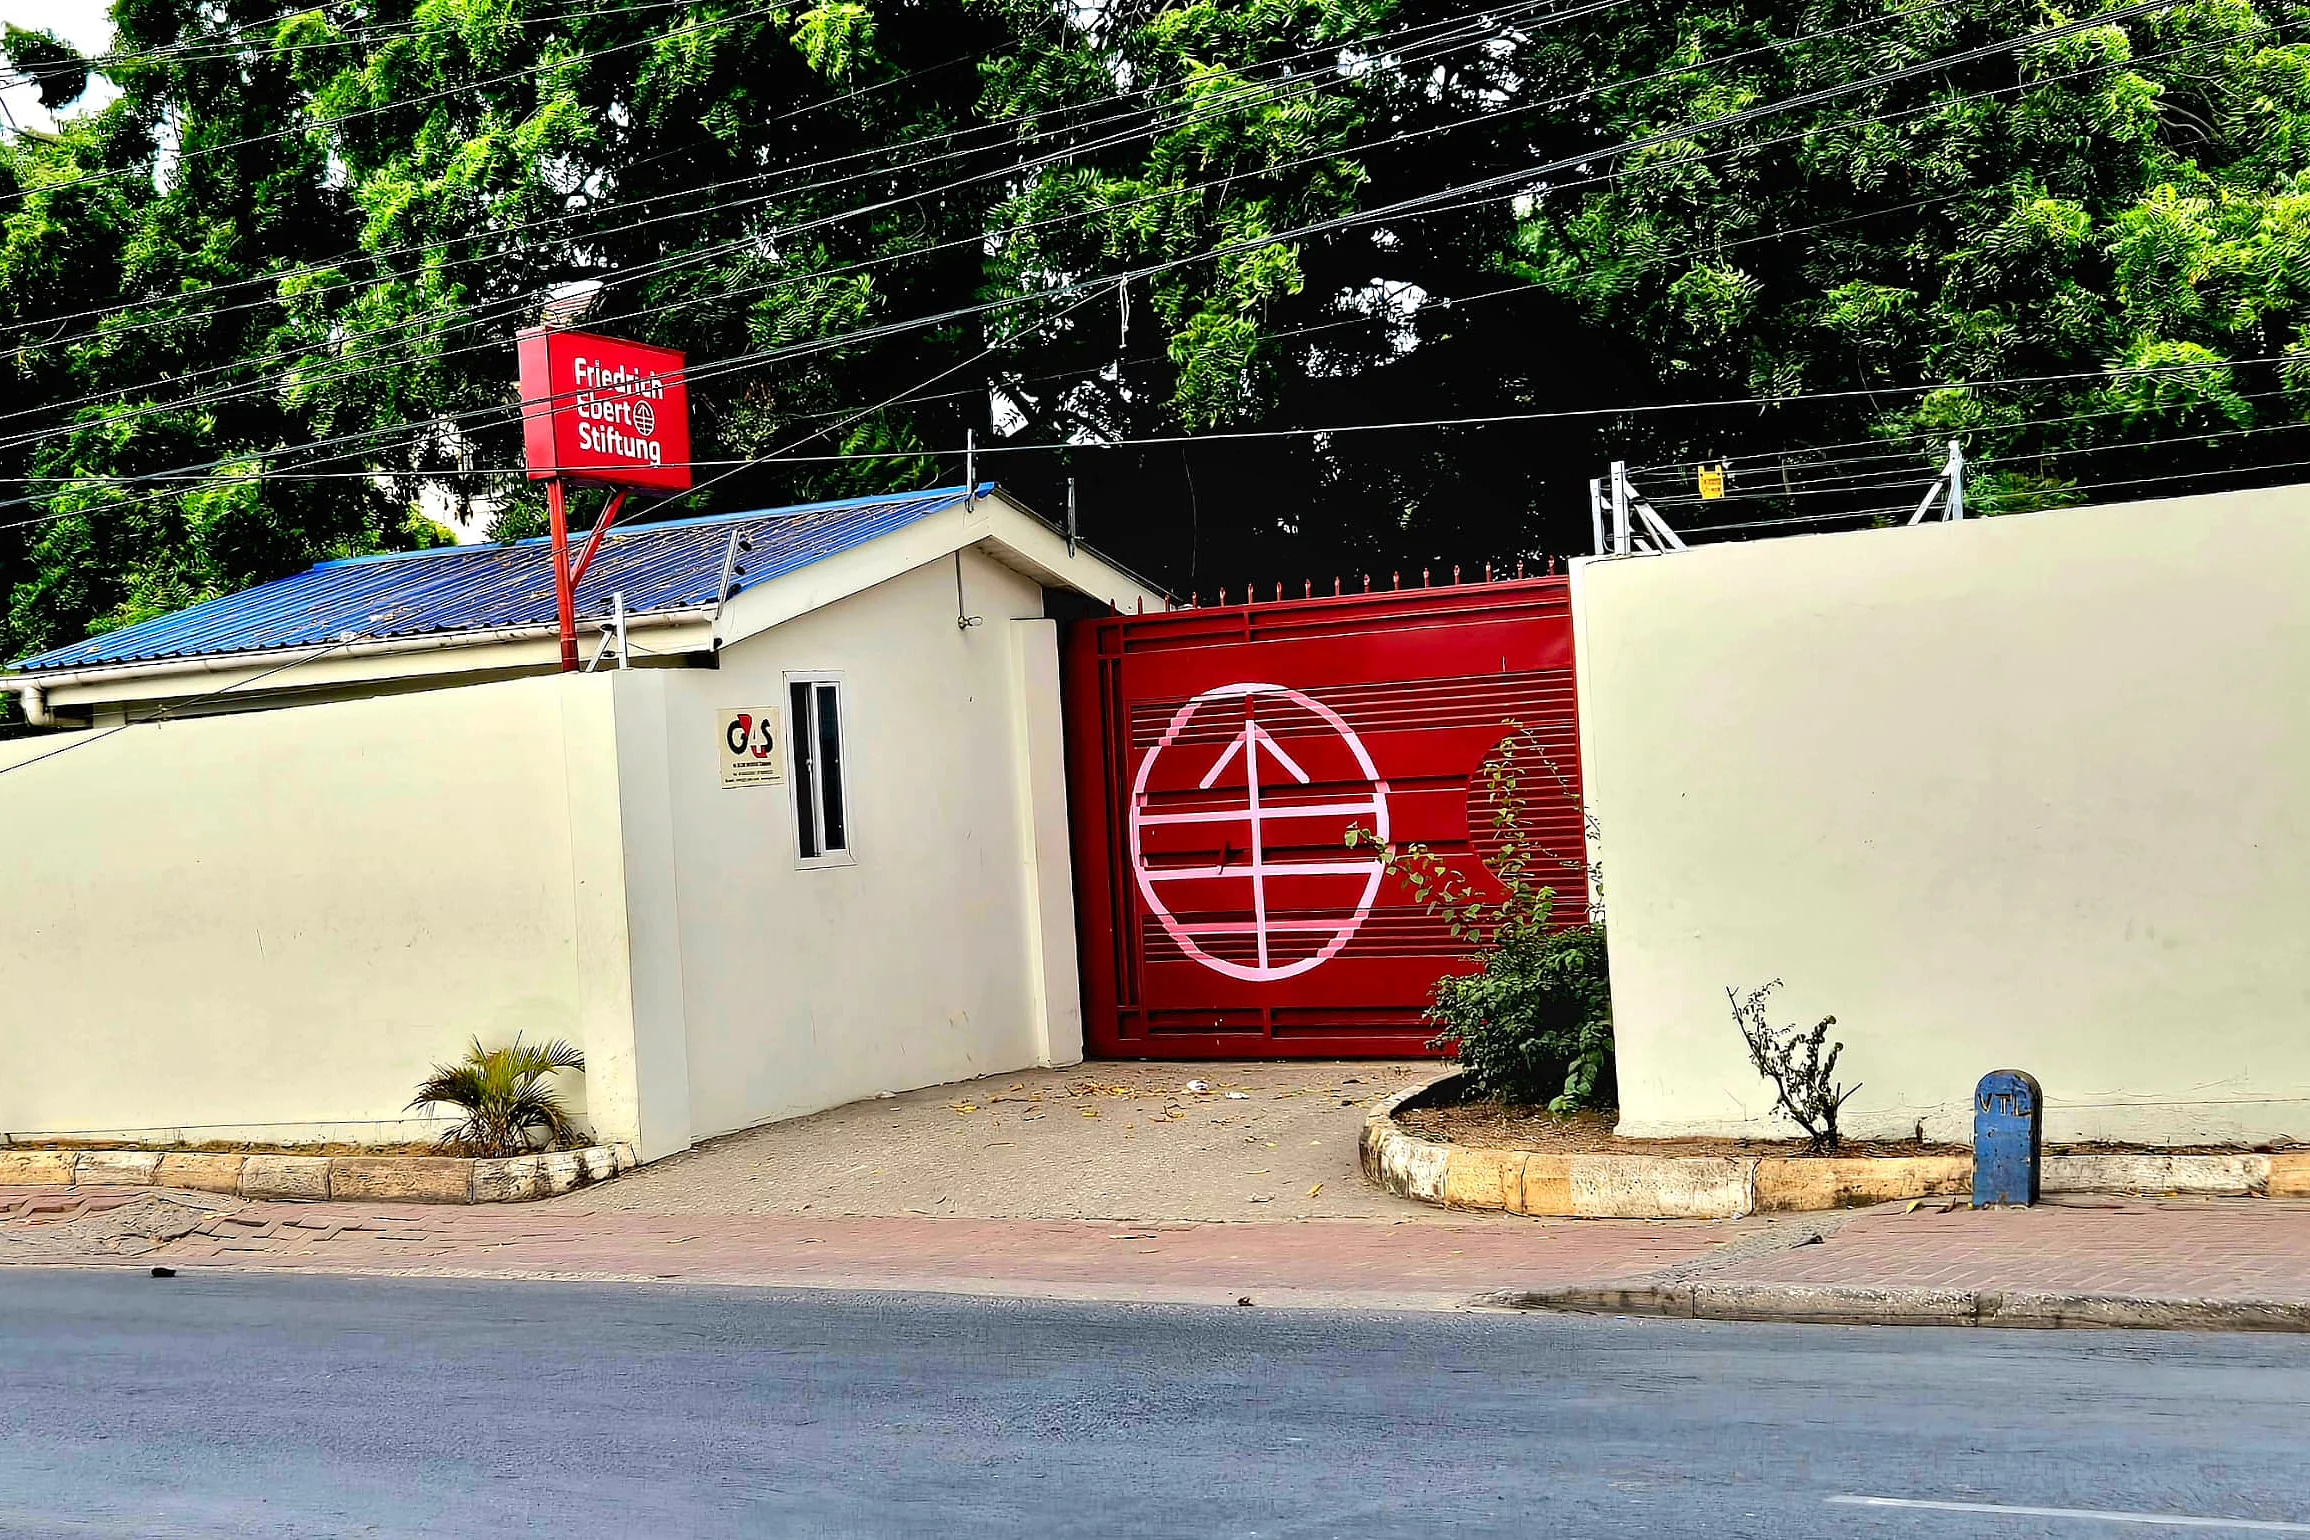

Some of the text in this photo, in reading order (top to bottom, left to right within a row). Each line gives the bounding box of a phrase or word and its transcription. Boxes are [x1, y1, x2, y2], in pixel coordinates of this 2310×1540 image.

[574, 357, 664, 400] Friedrich
[577, 389, 632, 426] Ebert
[579, 422, 662, 468] Stiftung
[727, 714, 774, 758] G4S
